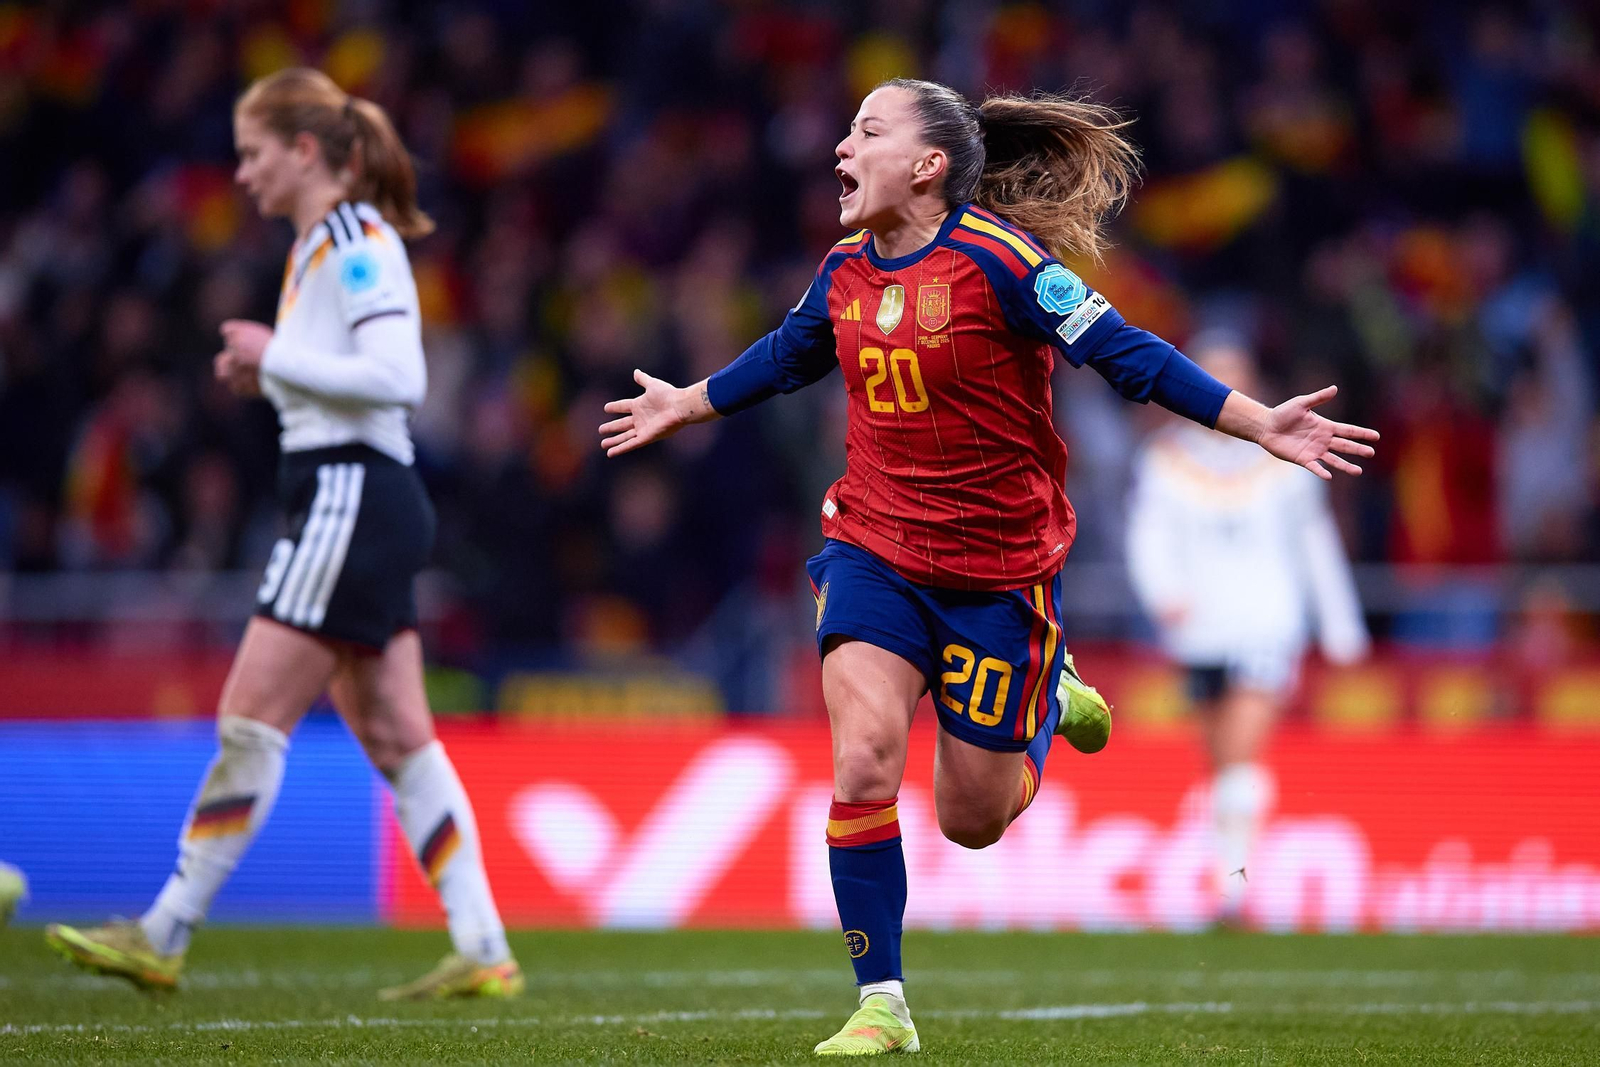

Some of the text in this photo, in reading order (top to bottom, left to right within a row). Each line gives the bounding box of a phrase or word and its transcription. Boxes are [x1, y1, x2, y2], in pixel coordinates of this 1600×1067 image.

[1062, 306, 1097, 339] FOUNDATION
[859, 347, 929, 413] 20
[940, 643, 1013, 727] 20
